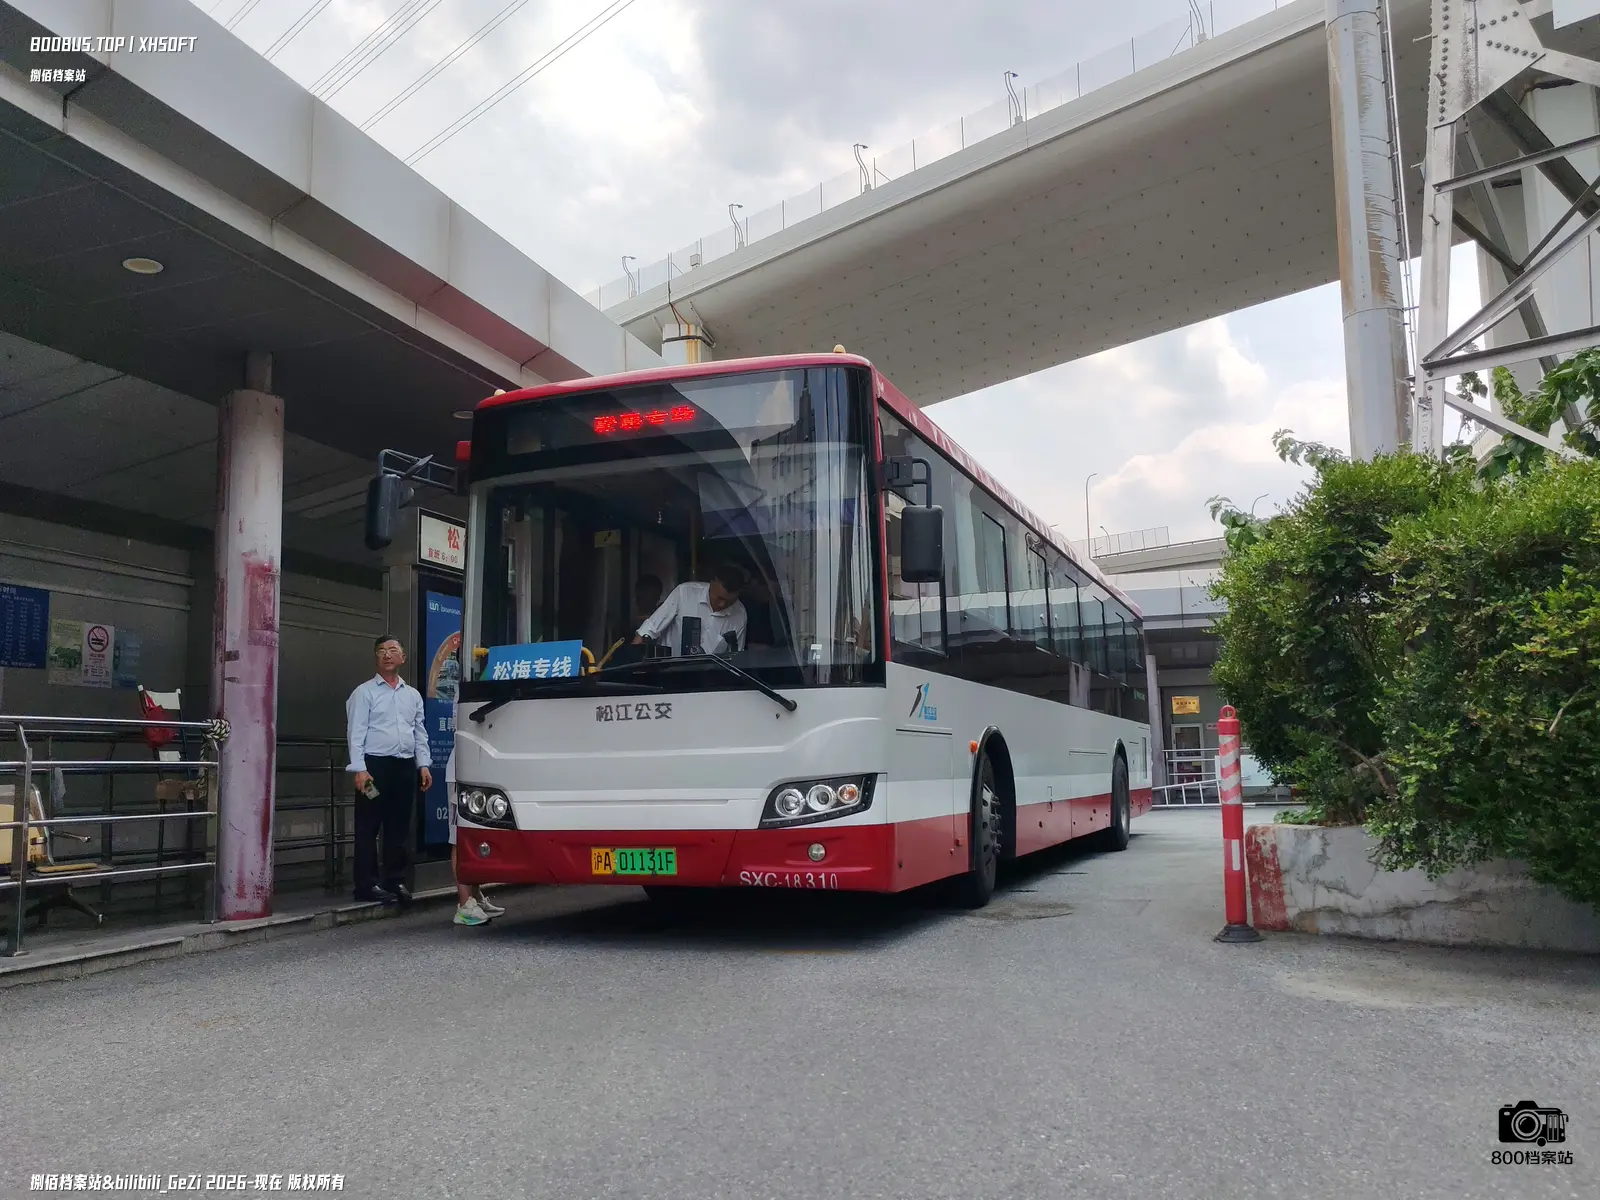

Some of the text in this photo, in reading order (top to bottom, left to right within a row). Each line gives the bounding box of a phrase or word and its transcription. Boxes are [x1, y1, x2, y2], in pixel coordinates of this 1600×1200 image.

[492, 656, 572, 680] 松梅专线
[596, 702, 673, 723] 松江公交
